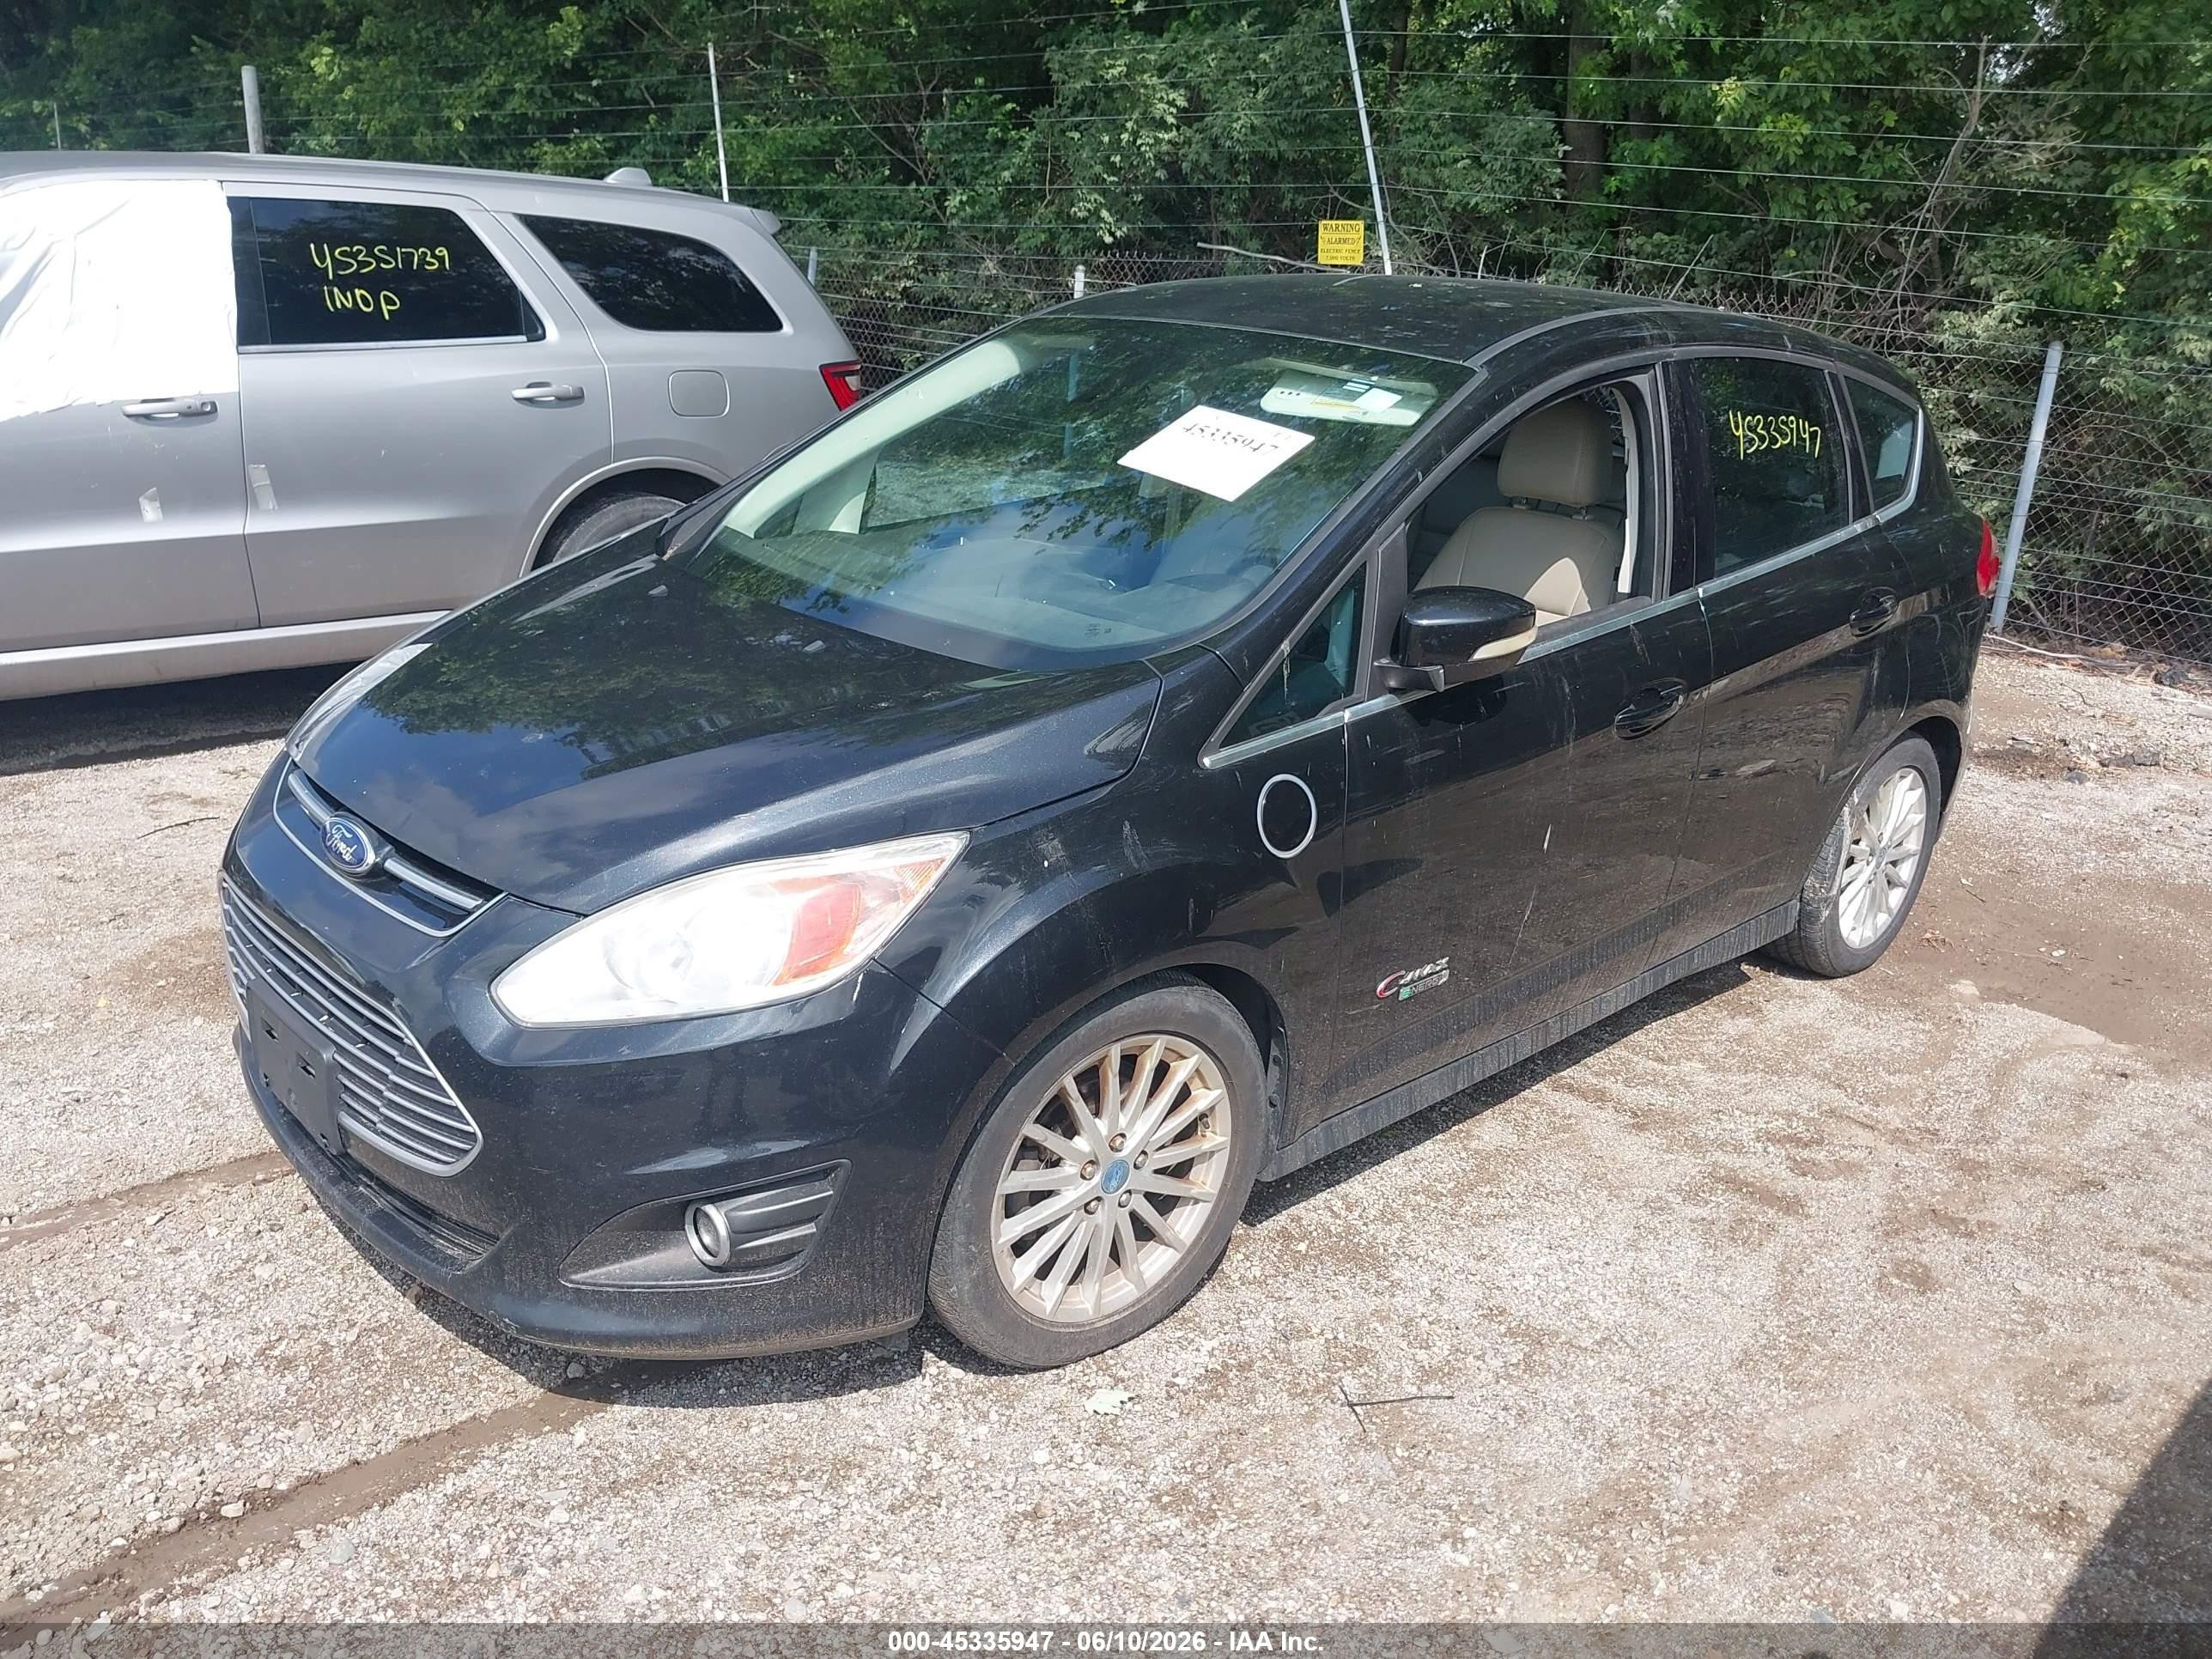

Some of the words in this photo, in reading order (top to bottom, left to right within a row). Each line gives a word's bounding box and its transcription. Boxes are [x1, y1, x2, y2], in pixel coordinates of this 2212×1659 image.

[1322, 222, 1360, 233] WARNING
[1327, 237, 1356, 246] ALARMED
[324, 285, 401, 321] INOP
[1182, 422, 1279, 456] 45335947
[1729, 410, 1821, 460] 45335947
[325, 824, 358, 864] Ford
